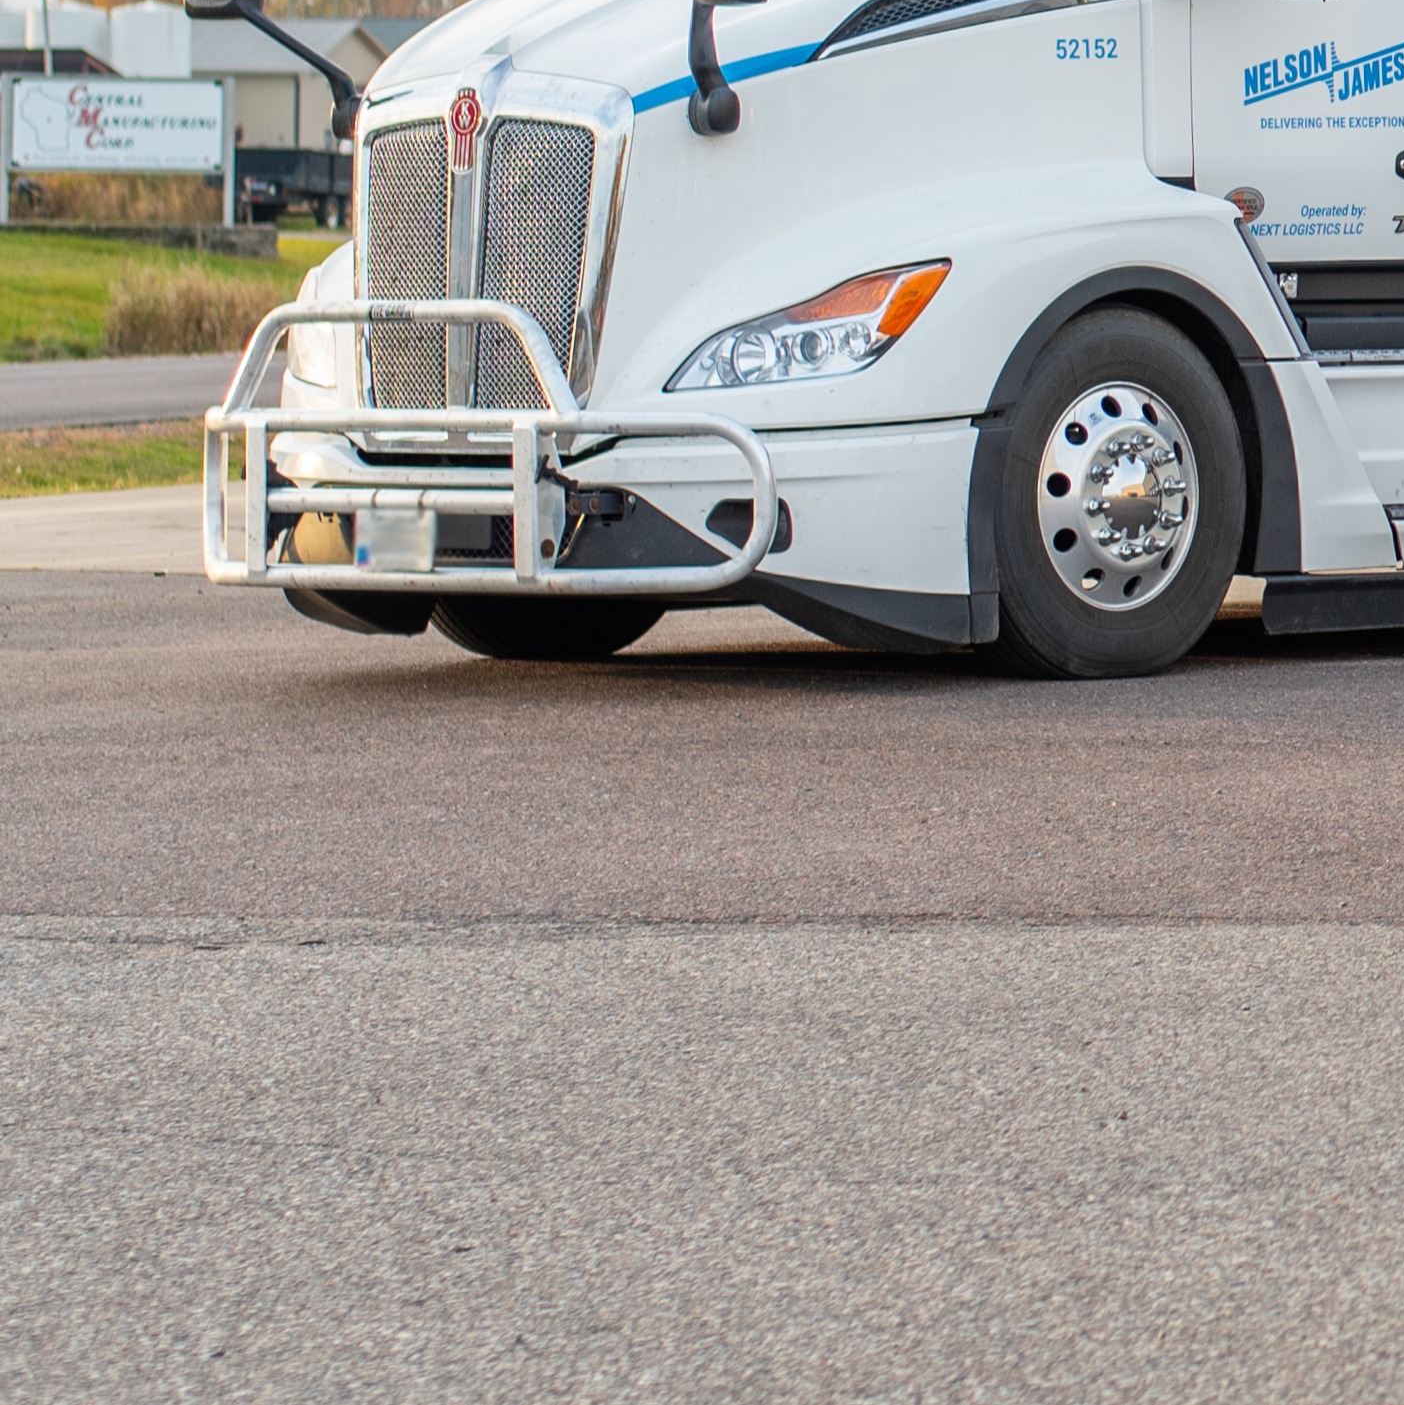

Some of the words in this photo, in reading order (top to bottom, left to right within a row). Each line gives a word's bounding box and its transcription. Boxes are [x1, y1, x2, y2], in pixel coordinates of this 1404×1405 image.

[1056, 38, 1118, 59] 52152
[1244, 42, 1327, 97] NELSON
[1260, 118, 1323, 129] DELIVERING
[1327, 117, 1346, 128] THE
[1301, 205, 1348, 217] Operated
[1350, 204, 1366, 216] by:
[1250, 224, 1281, 237] NEXT
[1283, 223, 1341, 235] LOGISTICS
[1343, 222, 1363, 235] LLC
